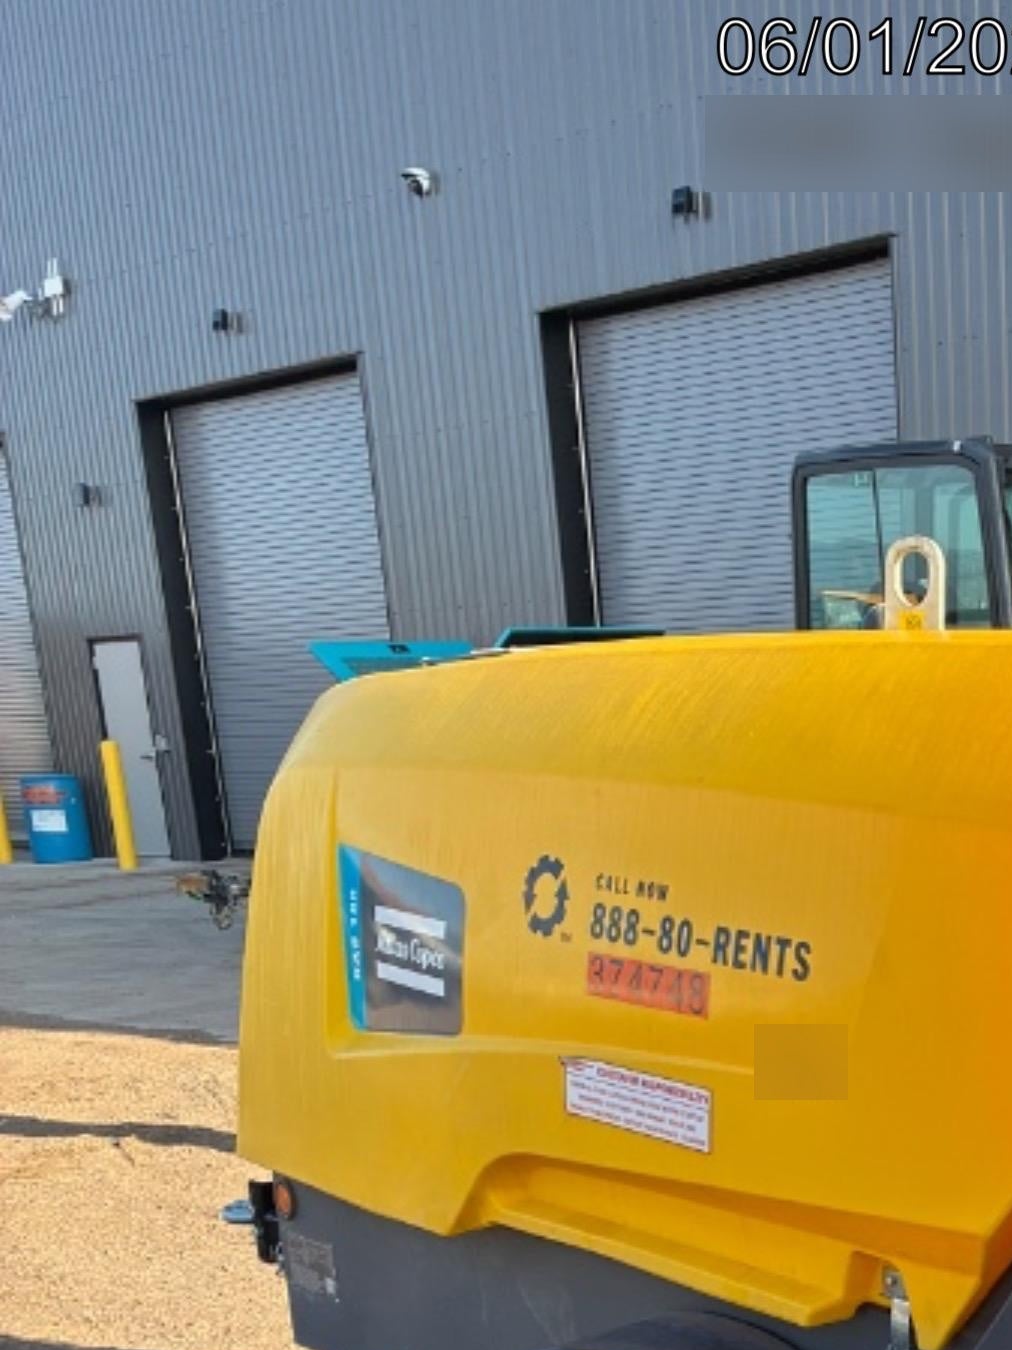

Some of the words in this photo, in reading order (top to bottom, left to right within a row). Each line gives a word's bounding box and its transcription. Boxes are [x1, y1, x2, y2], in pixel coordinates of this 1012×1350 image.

[596, 872, 630, 896] CALL
[635, 880, 669, 901] NOW
[590, 902, 812, 982] 888-80-RENTS
